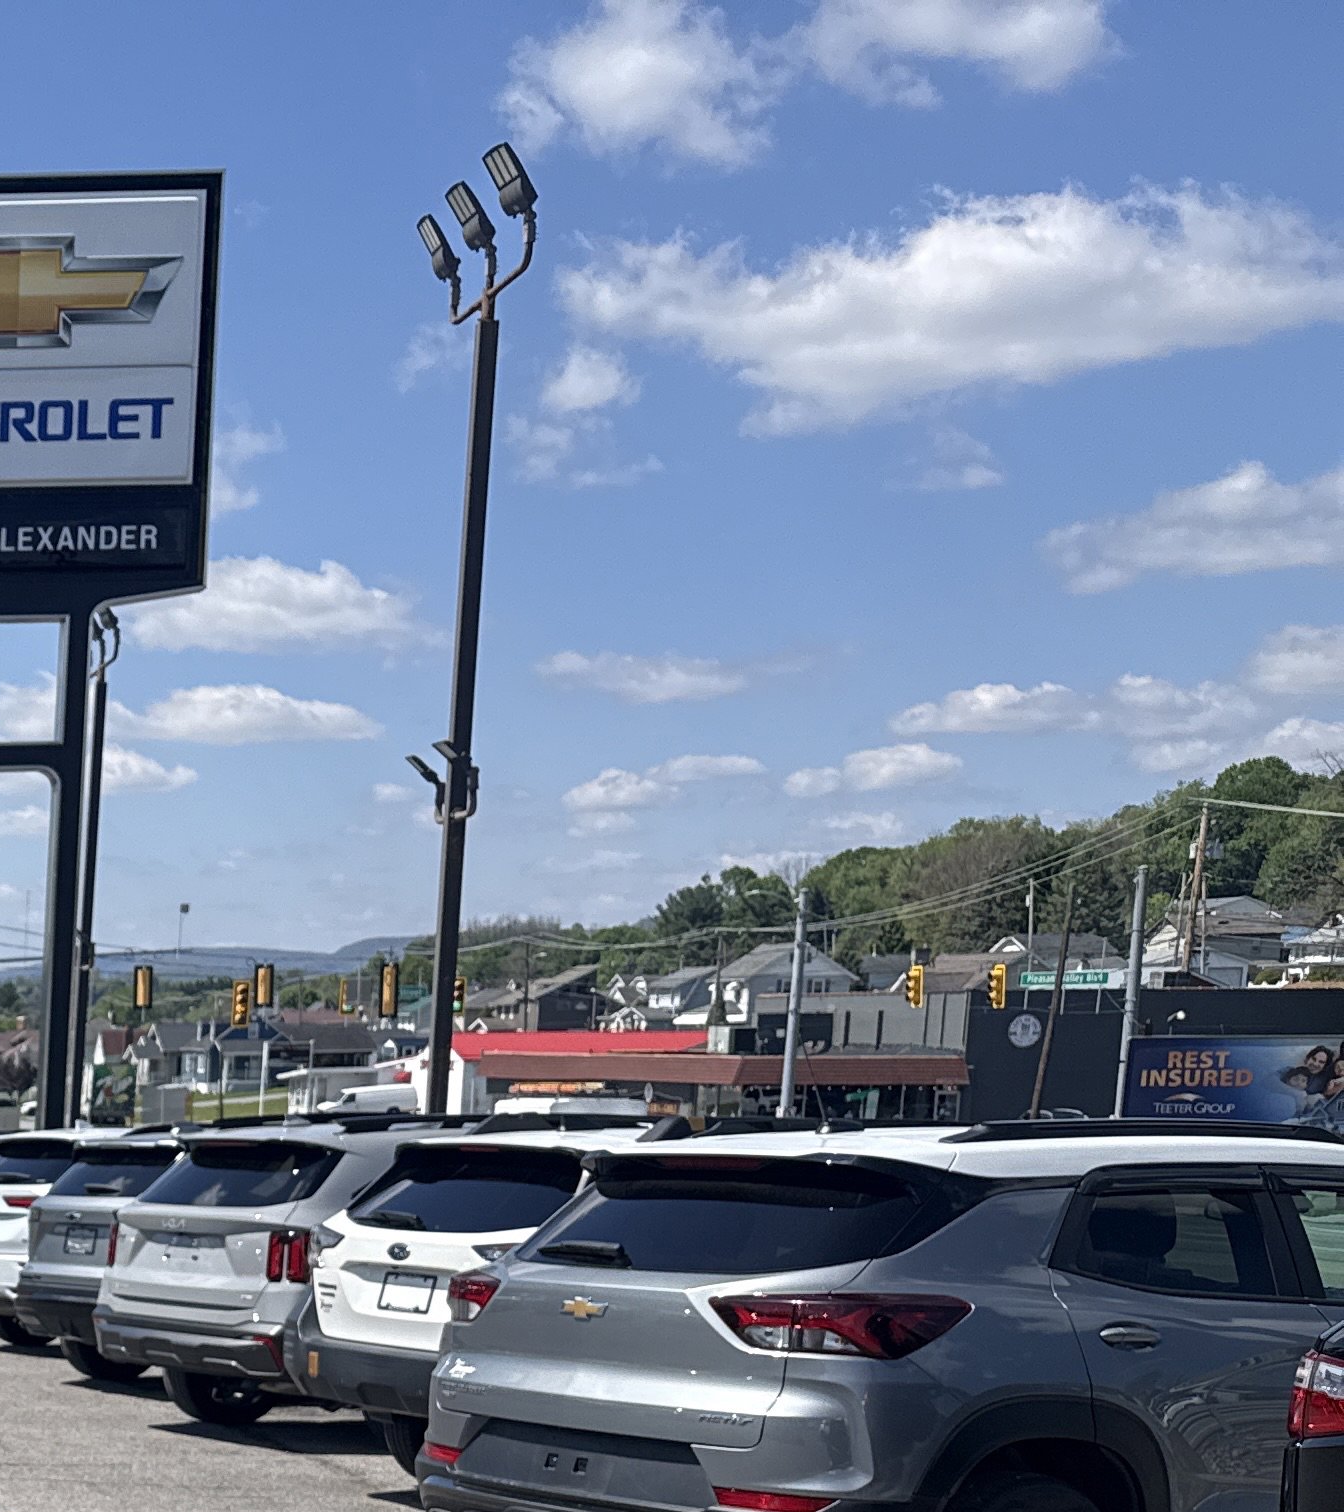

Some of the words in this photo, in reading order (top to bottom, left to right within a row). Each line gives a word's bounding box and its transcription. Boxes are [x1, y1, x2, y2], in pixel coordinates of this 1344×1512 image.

[1167, 1051, 1231, 1069] REST
[1140, 1069, 1253, 1087] INSURED
[1153, 1102, 1192, 1113] TEETER
[1194, 1102, 1235, 1114] GROUP
